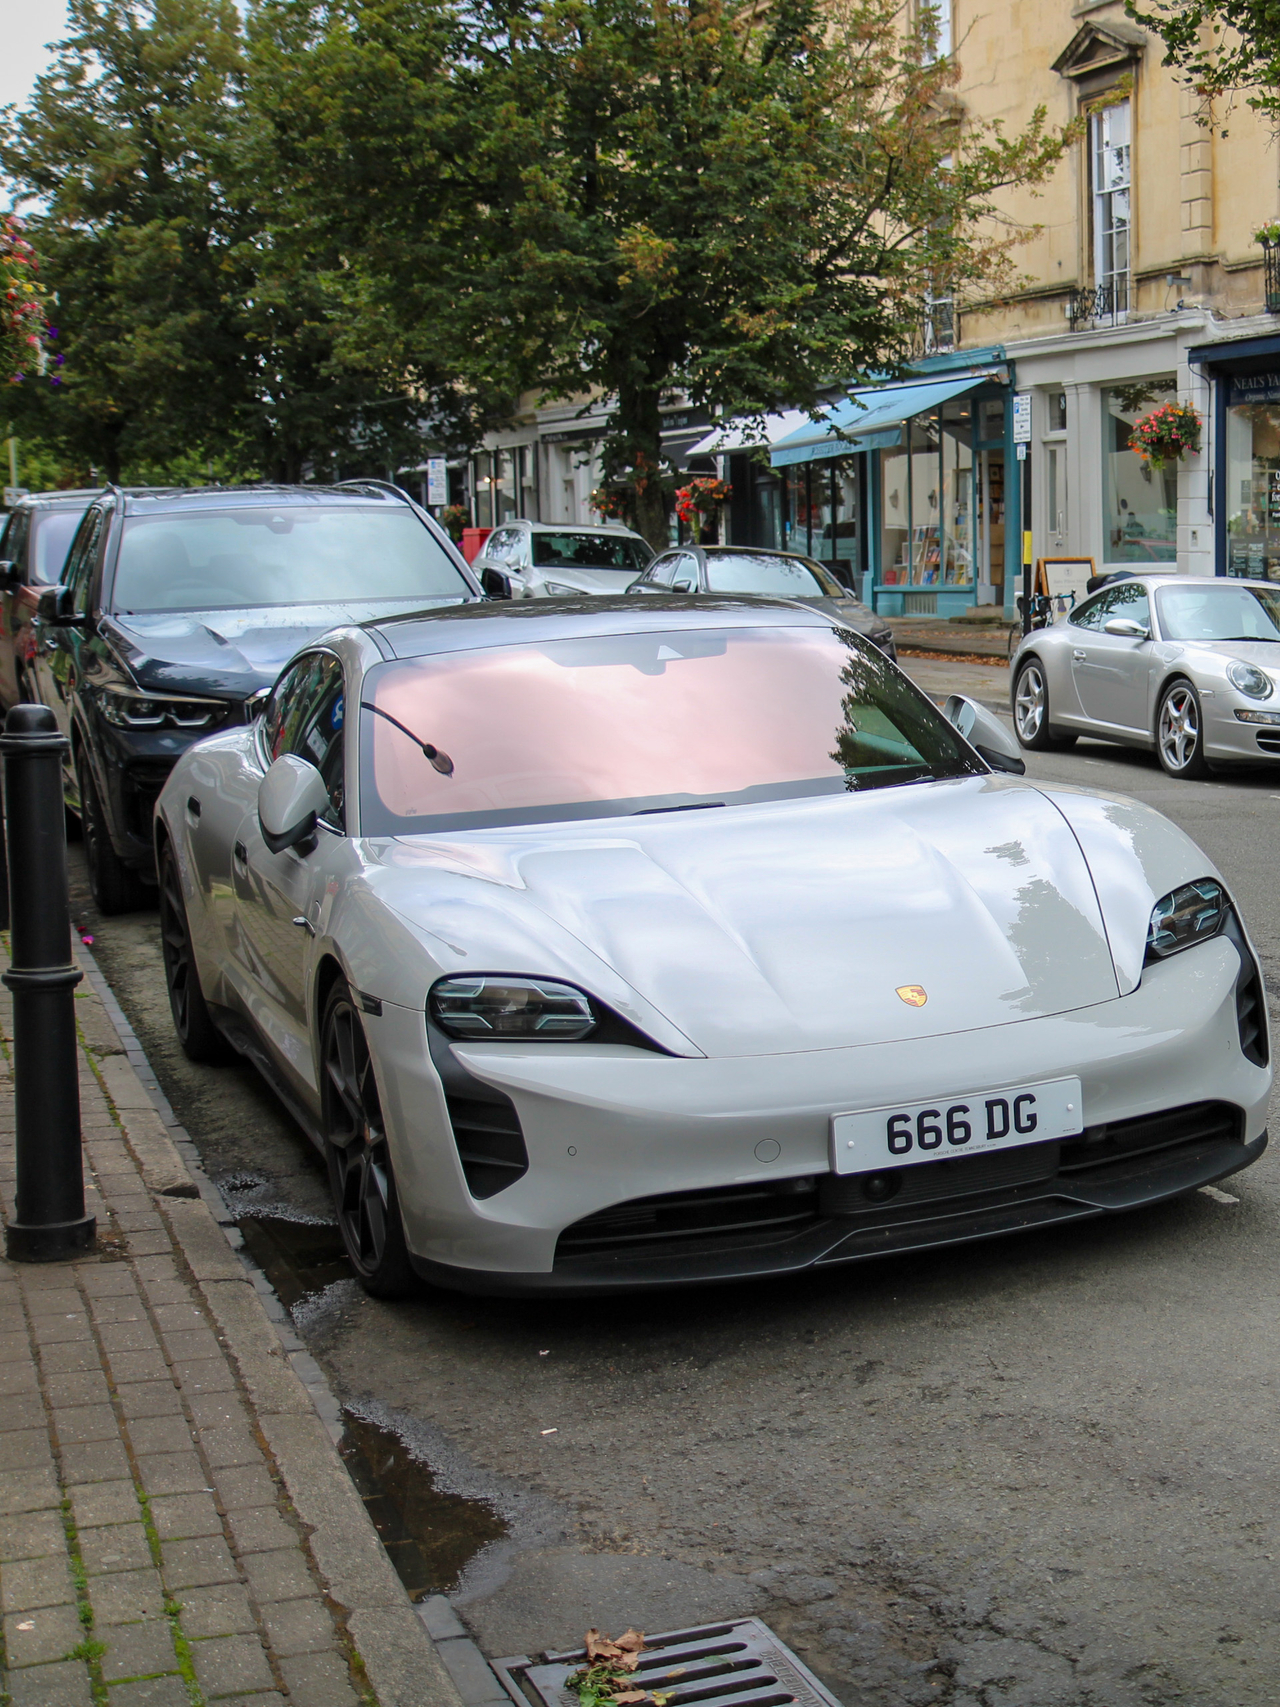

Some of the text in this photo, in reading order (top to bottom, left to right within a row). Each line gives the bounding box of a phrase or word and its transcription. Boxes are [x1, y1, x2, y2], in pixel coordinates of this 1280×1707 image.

[1233, 376, 1265, 391] NEAL'S
[886, 1093, 1038, 1155] 666 DG
